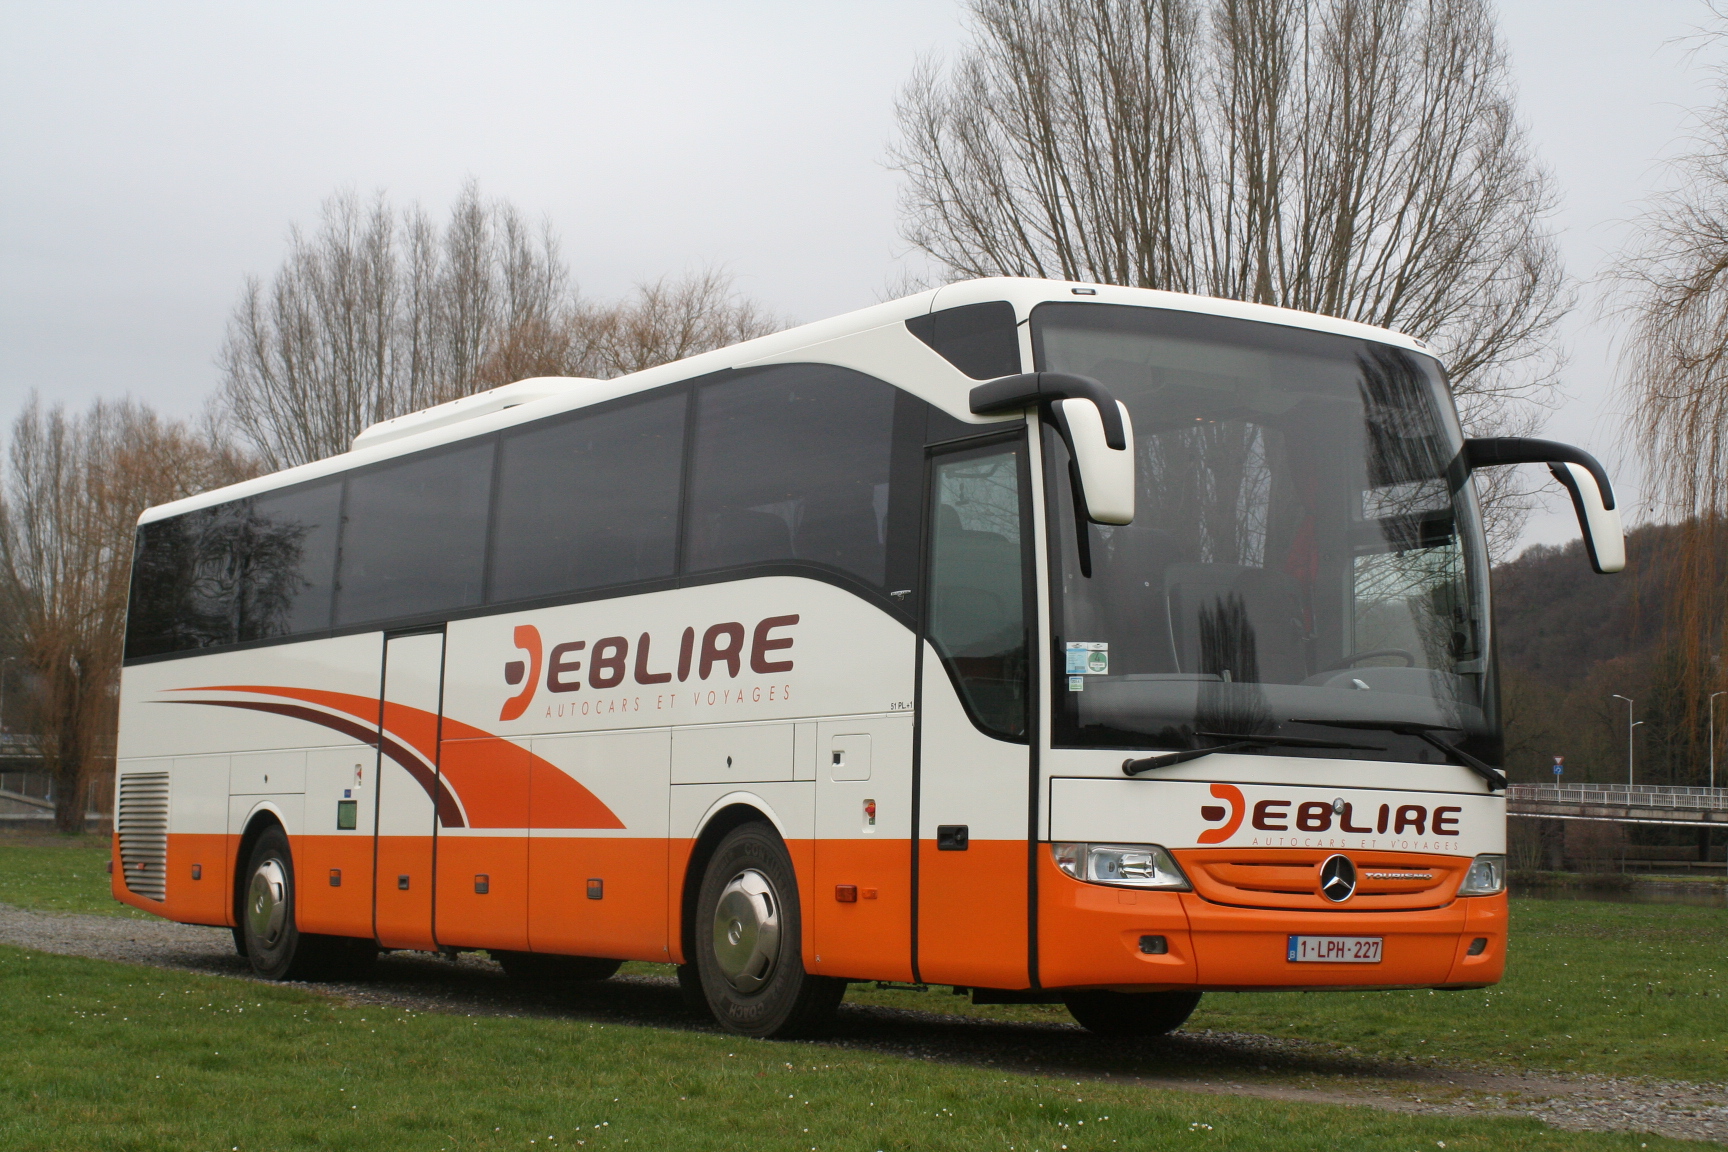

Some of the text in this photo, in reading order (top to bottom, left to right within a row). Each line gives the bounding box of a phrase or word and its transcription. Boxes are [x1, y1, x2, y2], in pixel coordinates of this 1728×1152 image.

[499, 614, 800, 721] DEBLIRE
[545, 684, 790, 718] AUTOCARS ET VOYAGES
[890, 702, 897, 710] 51
[1252, 837, 1459, 851] AUTOCARS ET VOYAGES
[1365, 872, 1433, 880] TOURISMO
[1289, 950, 1296, 959] B
[729, 1002, 765, 1019] COACH
